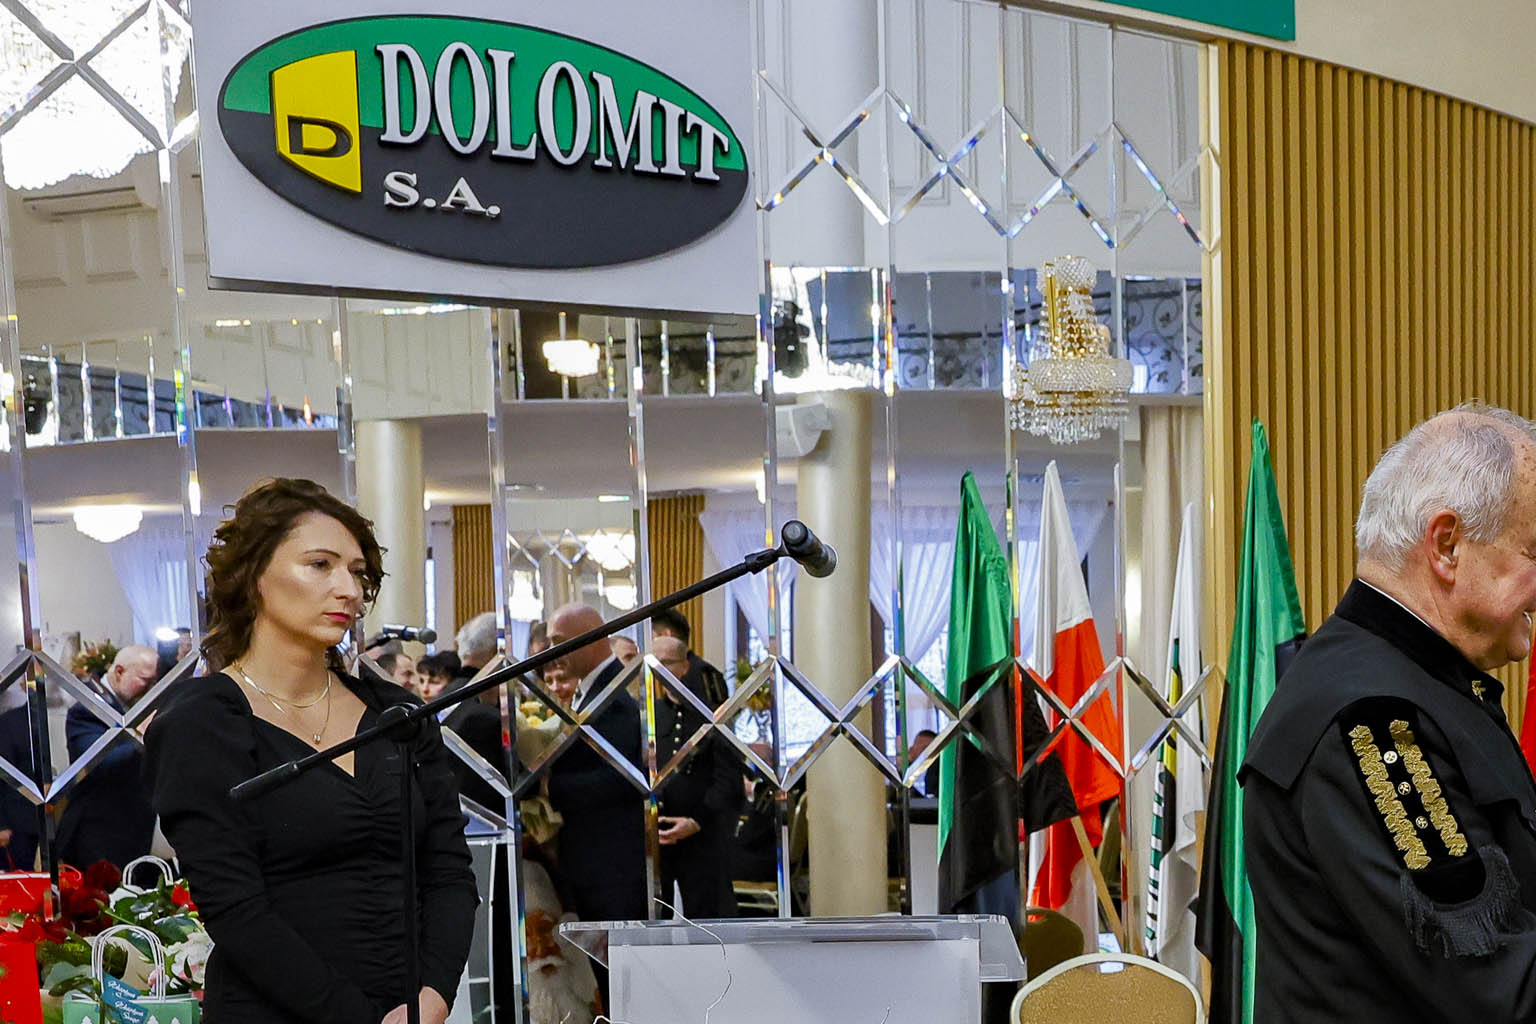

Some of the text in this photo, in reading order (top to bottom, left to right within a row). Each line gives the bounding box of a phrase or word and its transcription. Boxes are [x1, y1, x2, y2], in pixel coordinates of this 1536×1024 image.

[375, 41, 729, 182] DOLOMIT
[287, 115, 354, 158] D
[383, 170, 501, 218] S.A.
